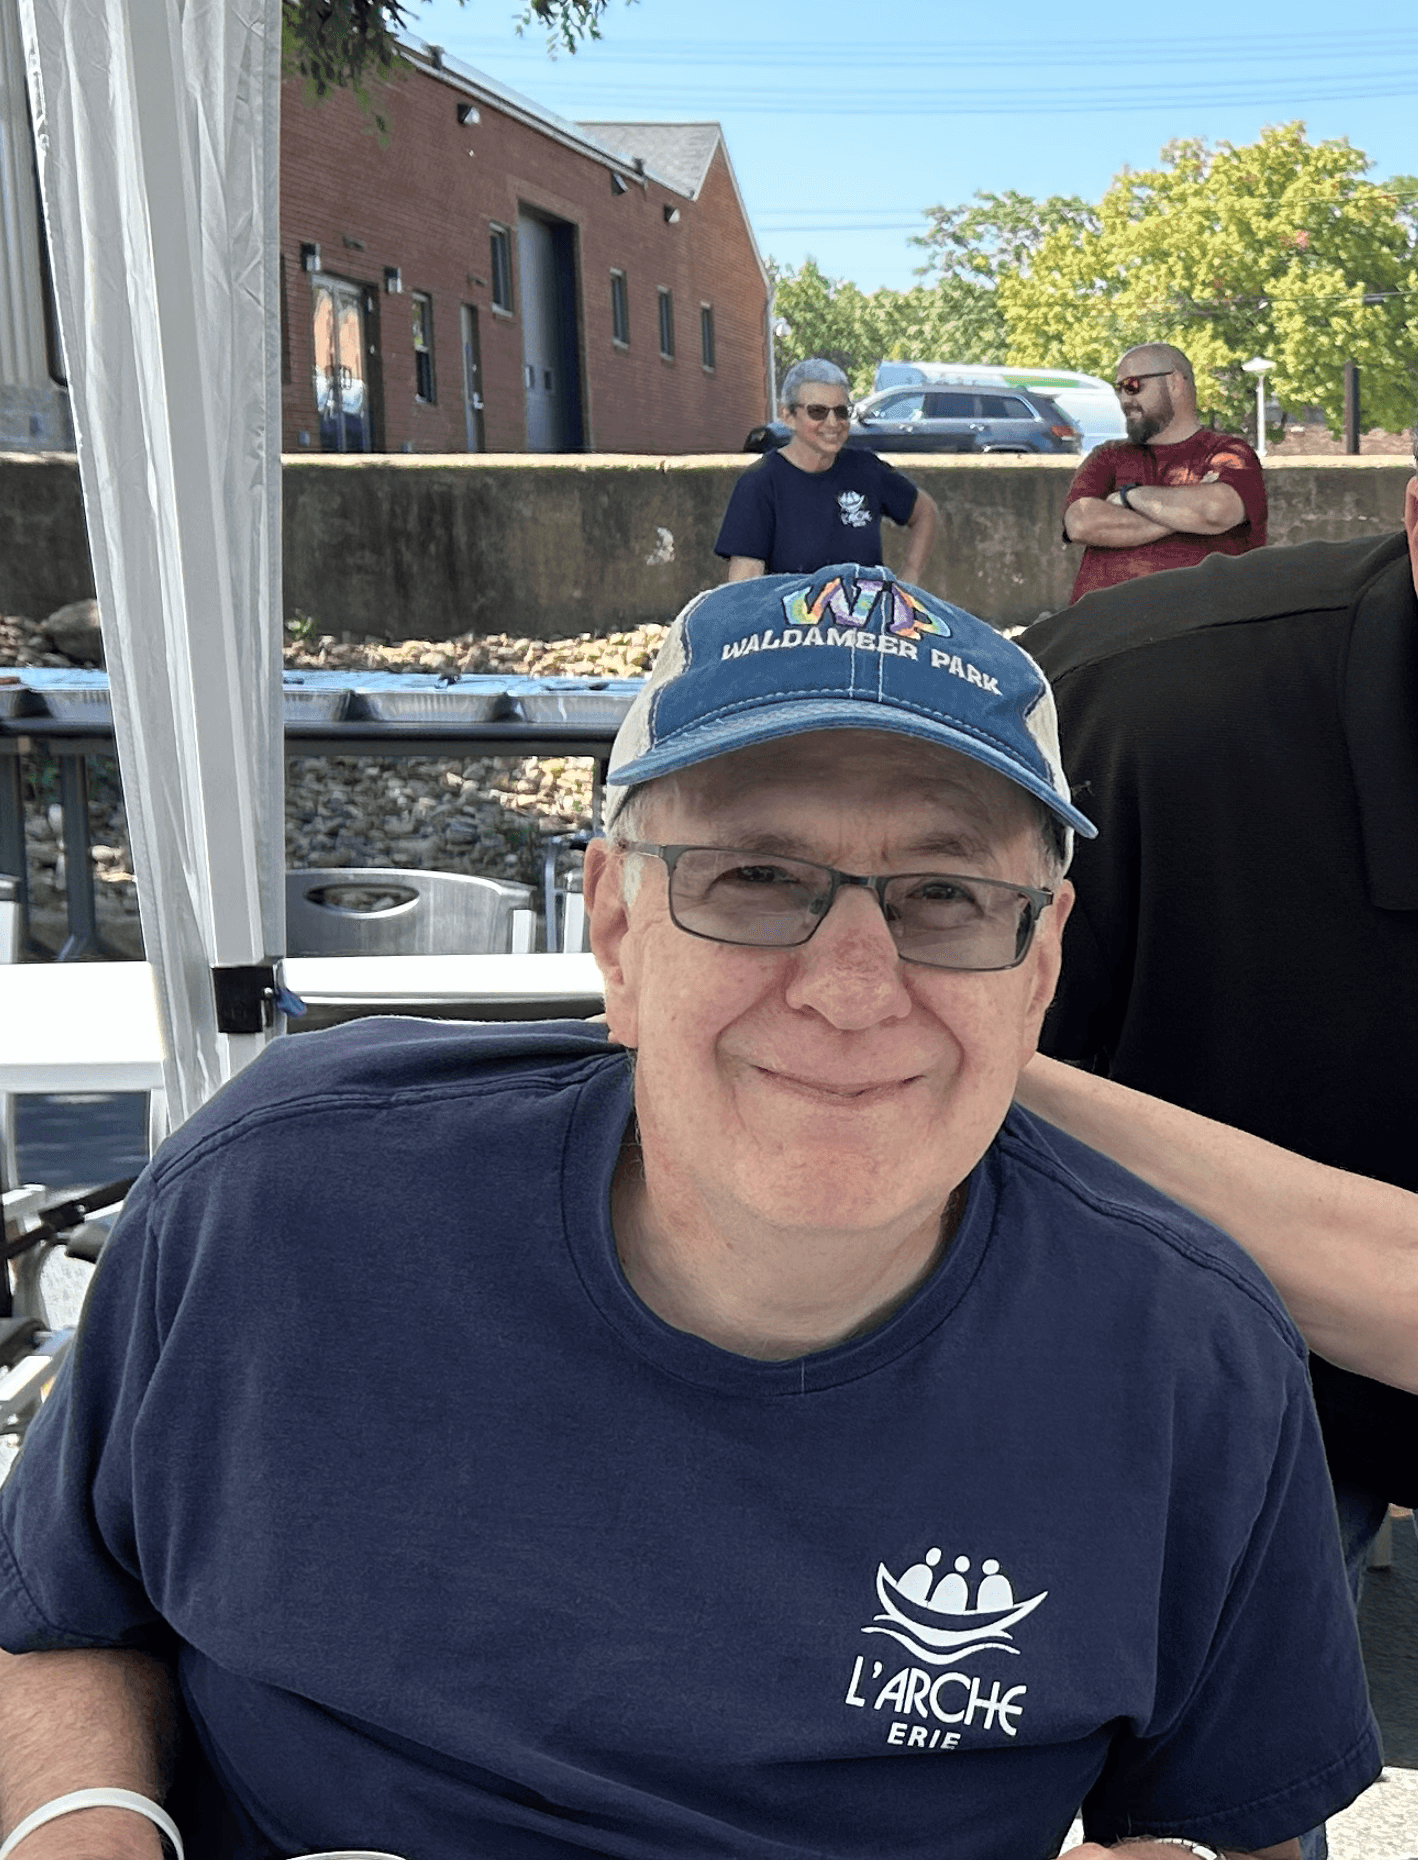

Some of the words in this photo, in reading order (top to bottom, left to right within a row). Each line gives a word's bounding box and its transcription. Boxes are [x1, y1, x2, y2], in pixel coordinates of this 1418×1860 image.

[721, 627, 919, 661] WALDAMEER
[930, 648, 1003, 696] PARK
[845, 1655, 1027, 1736] L'ARCHE
[887, 1721, 962, 1750] ERIE
